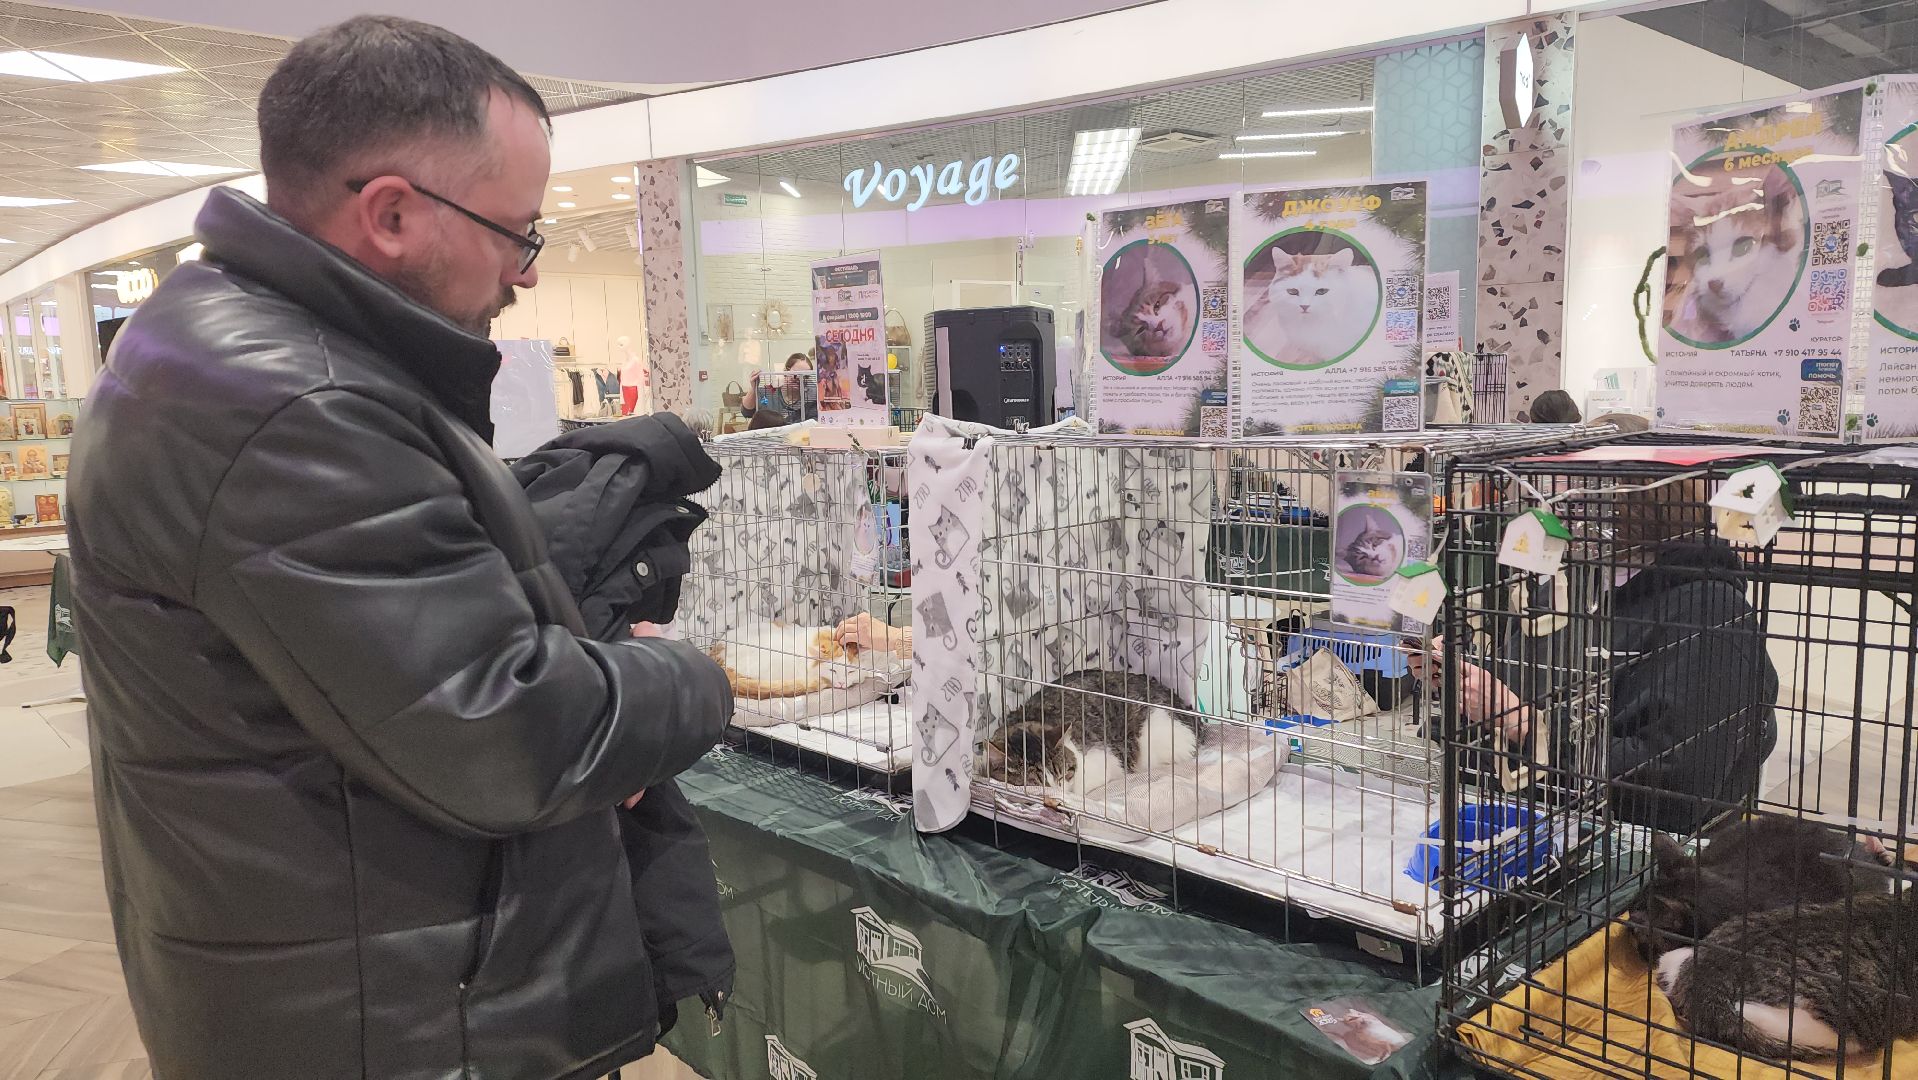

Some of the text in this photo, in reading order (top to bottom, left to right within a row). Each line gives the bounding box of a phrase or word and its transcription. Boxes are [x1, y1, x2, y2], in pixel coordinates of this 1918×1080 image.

[1723, 157, 1734, 172] 6
[843, 153, 1020, 212] Voyage
[1282, 195, 1382, 217] ДЖОЗЕФ
[826, 328, 875, 344] СЕГОДНЯ
[1785, 349, 1799, 357] 910
[1880, 363, 1917, 371] Ляйсан
[1878, 385, 1918, 396] потом б
[917, 992, 947, 1025] ДОМ
